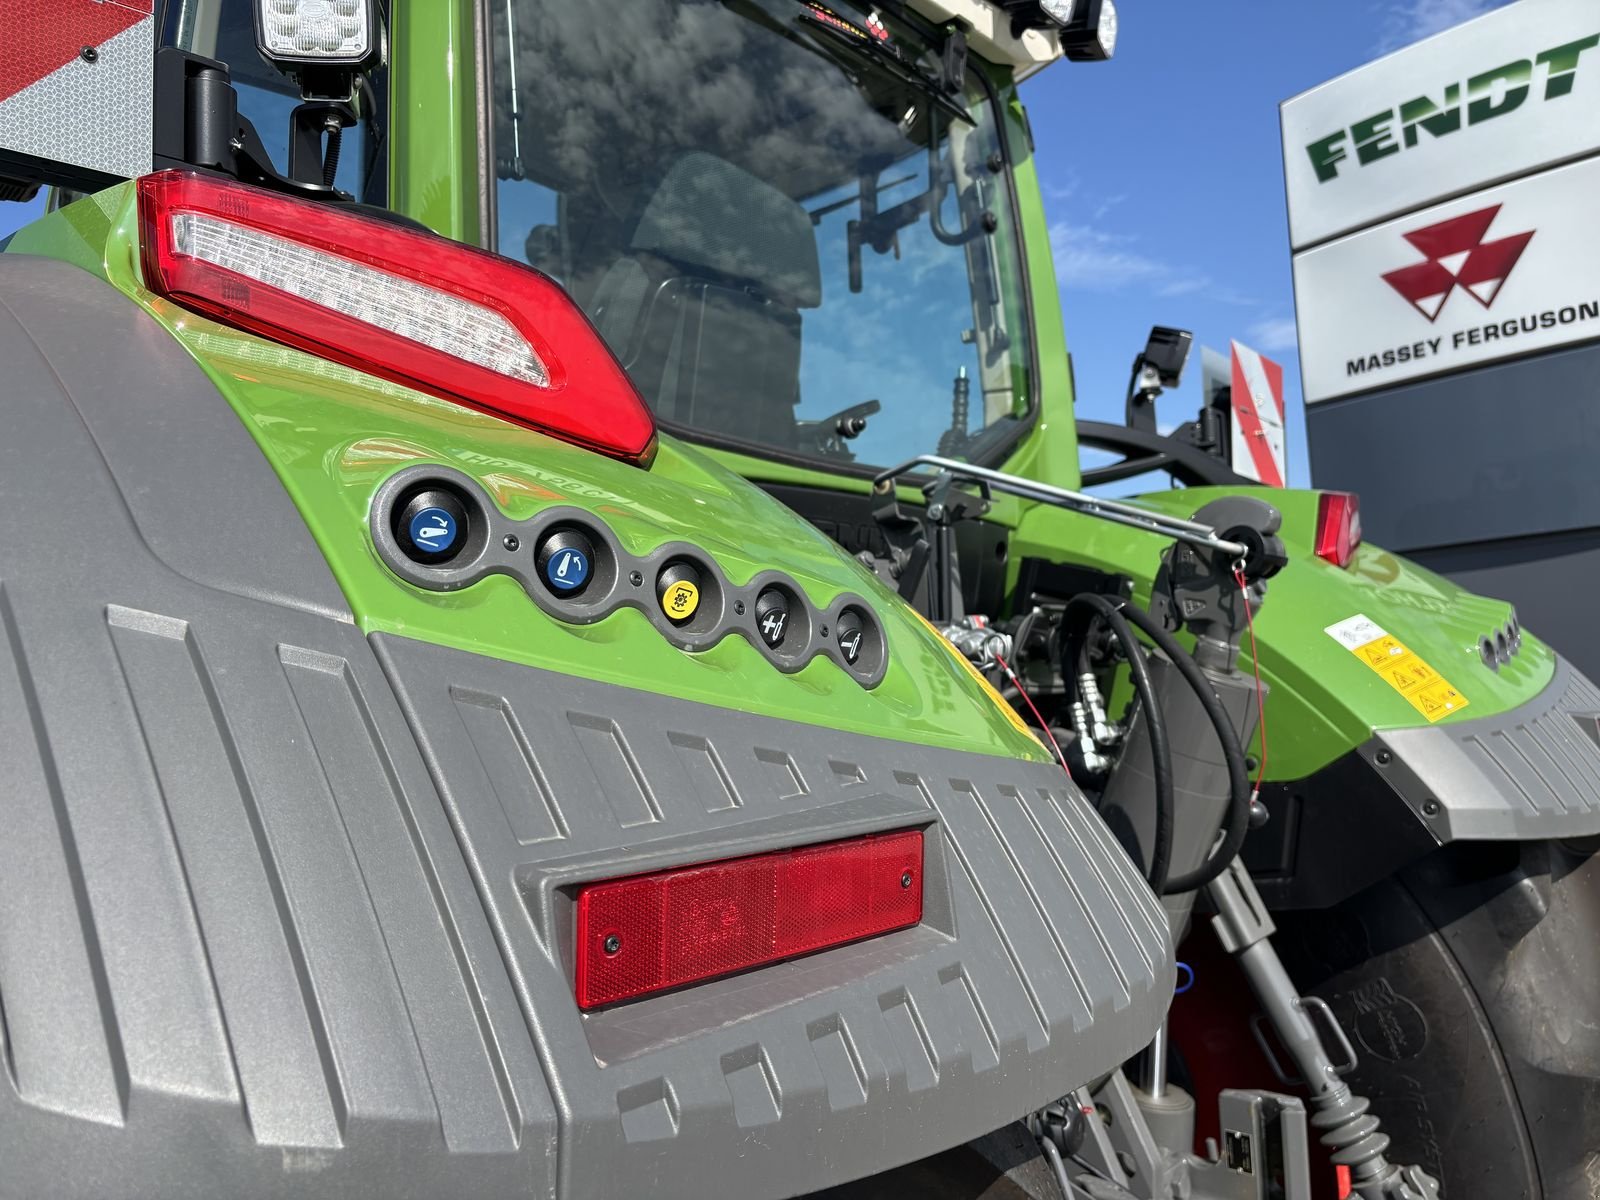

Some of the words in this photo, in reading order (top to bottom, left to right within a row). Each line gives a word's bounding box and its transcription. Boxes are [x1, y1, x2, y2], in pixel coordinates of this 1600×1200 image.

[1306, 32, 1600, 184] FENDT
[1346, 336, 1441, 377] MASSEY
[1453, 300, 1600, 349] FERGUSON
